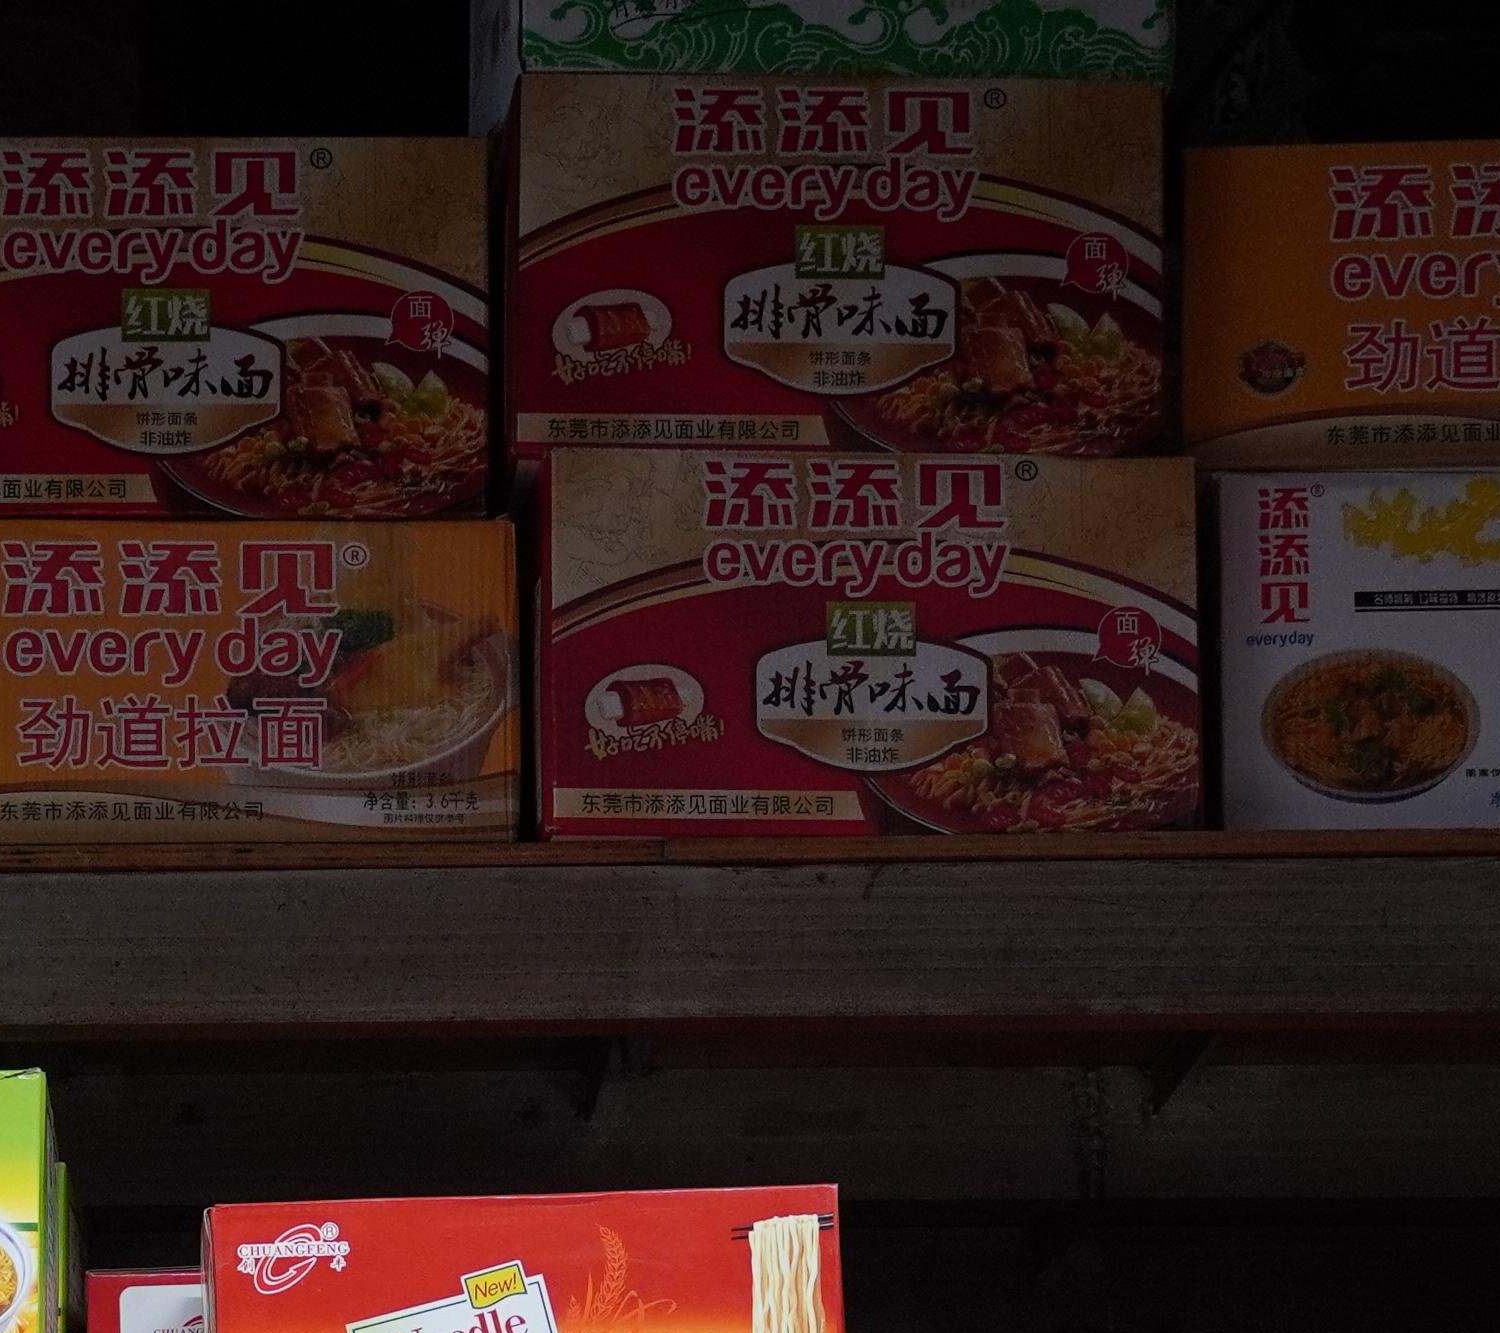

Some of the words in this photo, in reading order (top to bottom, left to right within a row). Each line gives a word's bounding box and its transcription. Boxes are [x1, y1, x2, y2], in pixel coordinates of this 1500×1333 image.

[674, 89, 974, 153] 添添见
[2, 150, 297, 215] 添添见
[675, 166, 854, 215] every
[866, 156, 975, 219] day
[3, 229, 178, 276] every
[196, 219, 302, 283] day
[797, 229, 882, 274] 红烧
[123, 292, 209, 339] 红烧
[731, 287, 949, 335] 排骨味面
[58, 347, 273, 401] 排骨味面
[136, 411, 198, 428] 饼形面条
[140, 429, 192, 447] 非油炸
[705, 461, 1005, 527] 添添见
[2, 541, 336, 615] 添添见
[1258, 488, 1310, 624] 添添见
[3, 628, 202, 686] every
[218, 619, 341, 686] day
[1246, 631, 1314, 648] everyday
[763, 664, 981, 713] 排骨味面
[19, 695, 327, 772] 劲道拉面
[0, 800, 265, 821] 东莞市添添见面业有限公司
[582, 795, 833, 816] 东莞市添添见面业有限公司
[237, 1243, 350, 1257] CHUANGFENG
[473, 1272, 518, 1300] New!
